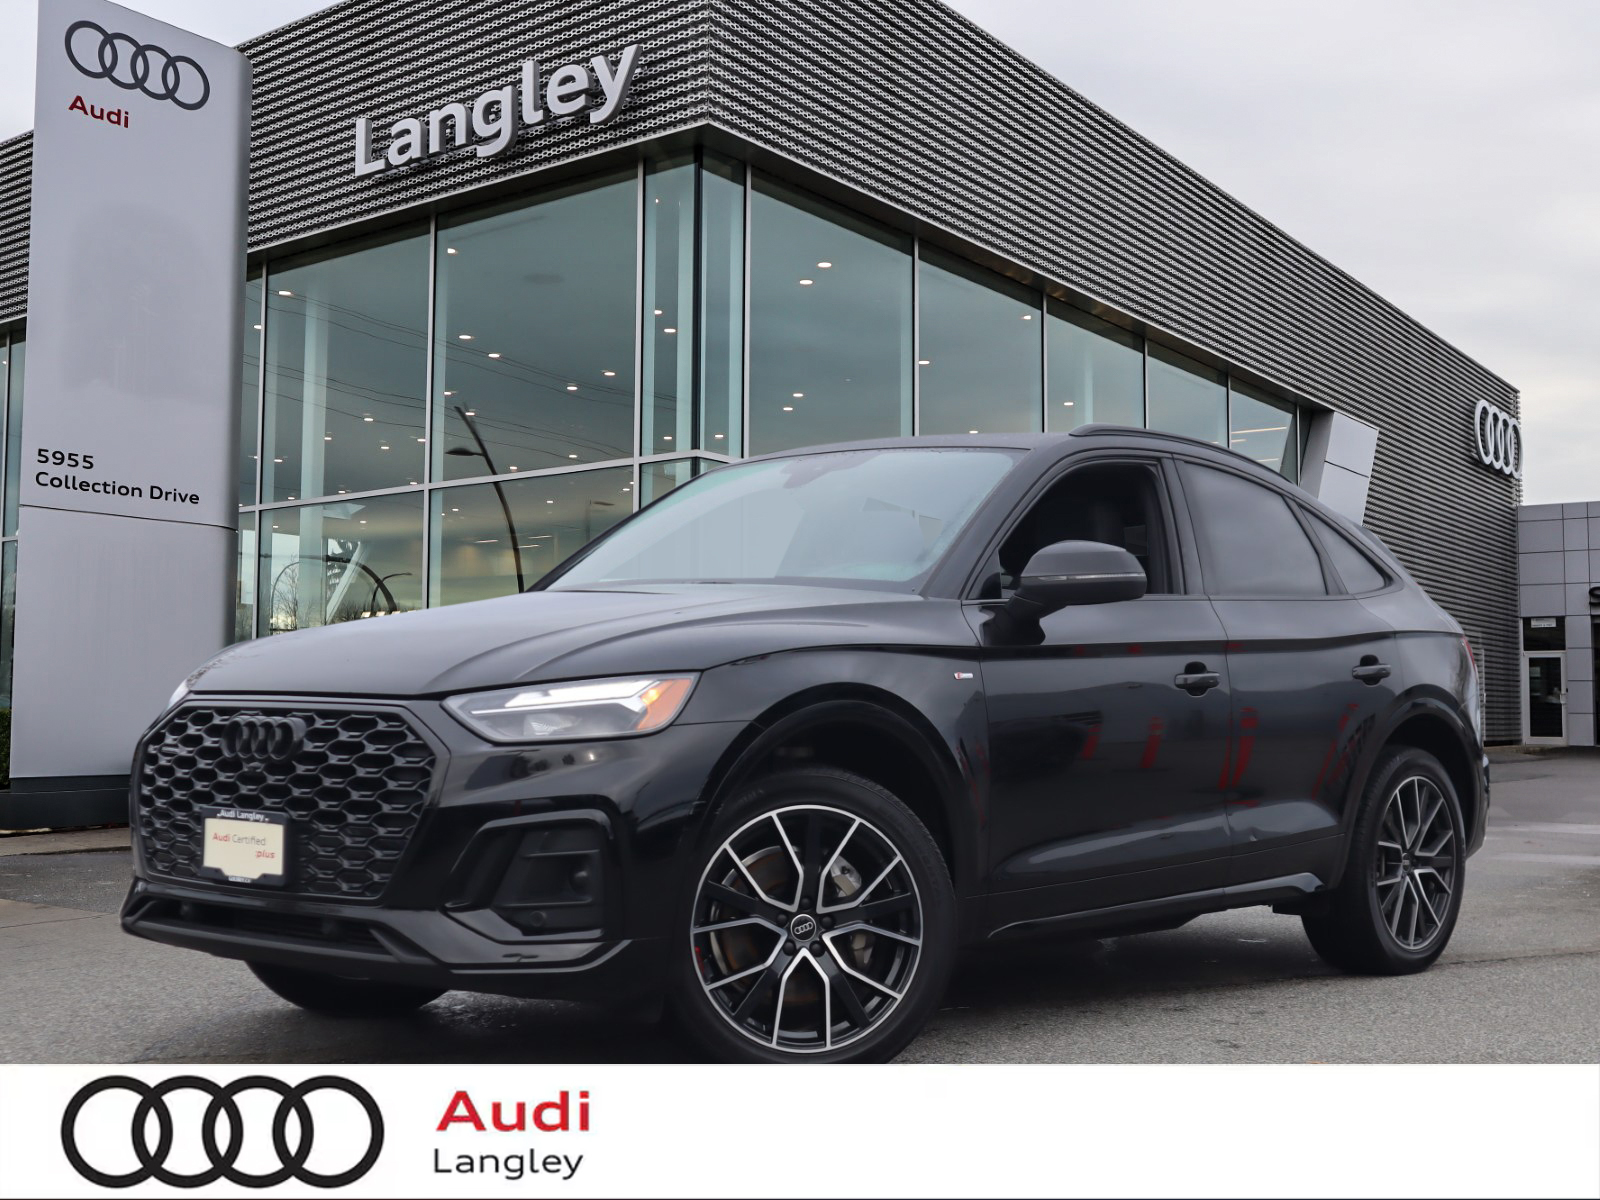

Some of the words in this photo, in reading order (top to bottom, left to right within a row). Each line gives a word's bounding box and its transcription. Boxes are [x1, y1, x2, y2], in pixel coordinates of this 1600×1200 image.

[68, 95, 129, 129] Audi
[354, 44, 643, 177] Langley
[36, 448, 95, 470] 5955
[35, 471, 143, 498] Collection
[149, 485, 200, 505] Drive
[218, 809, 236, 818] Audi
[237, 810, 265, 822] Langley
[212, 832, 231, 843] Audi
[232, 834, 266, 846] Certified
